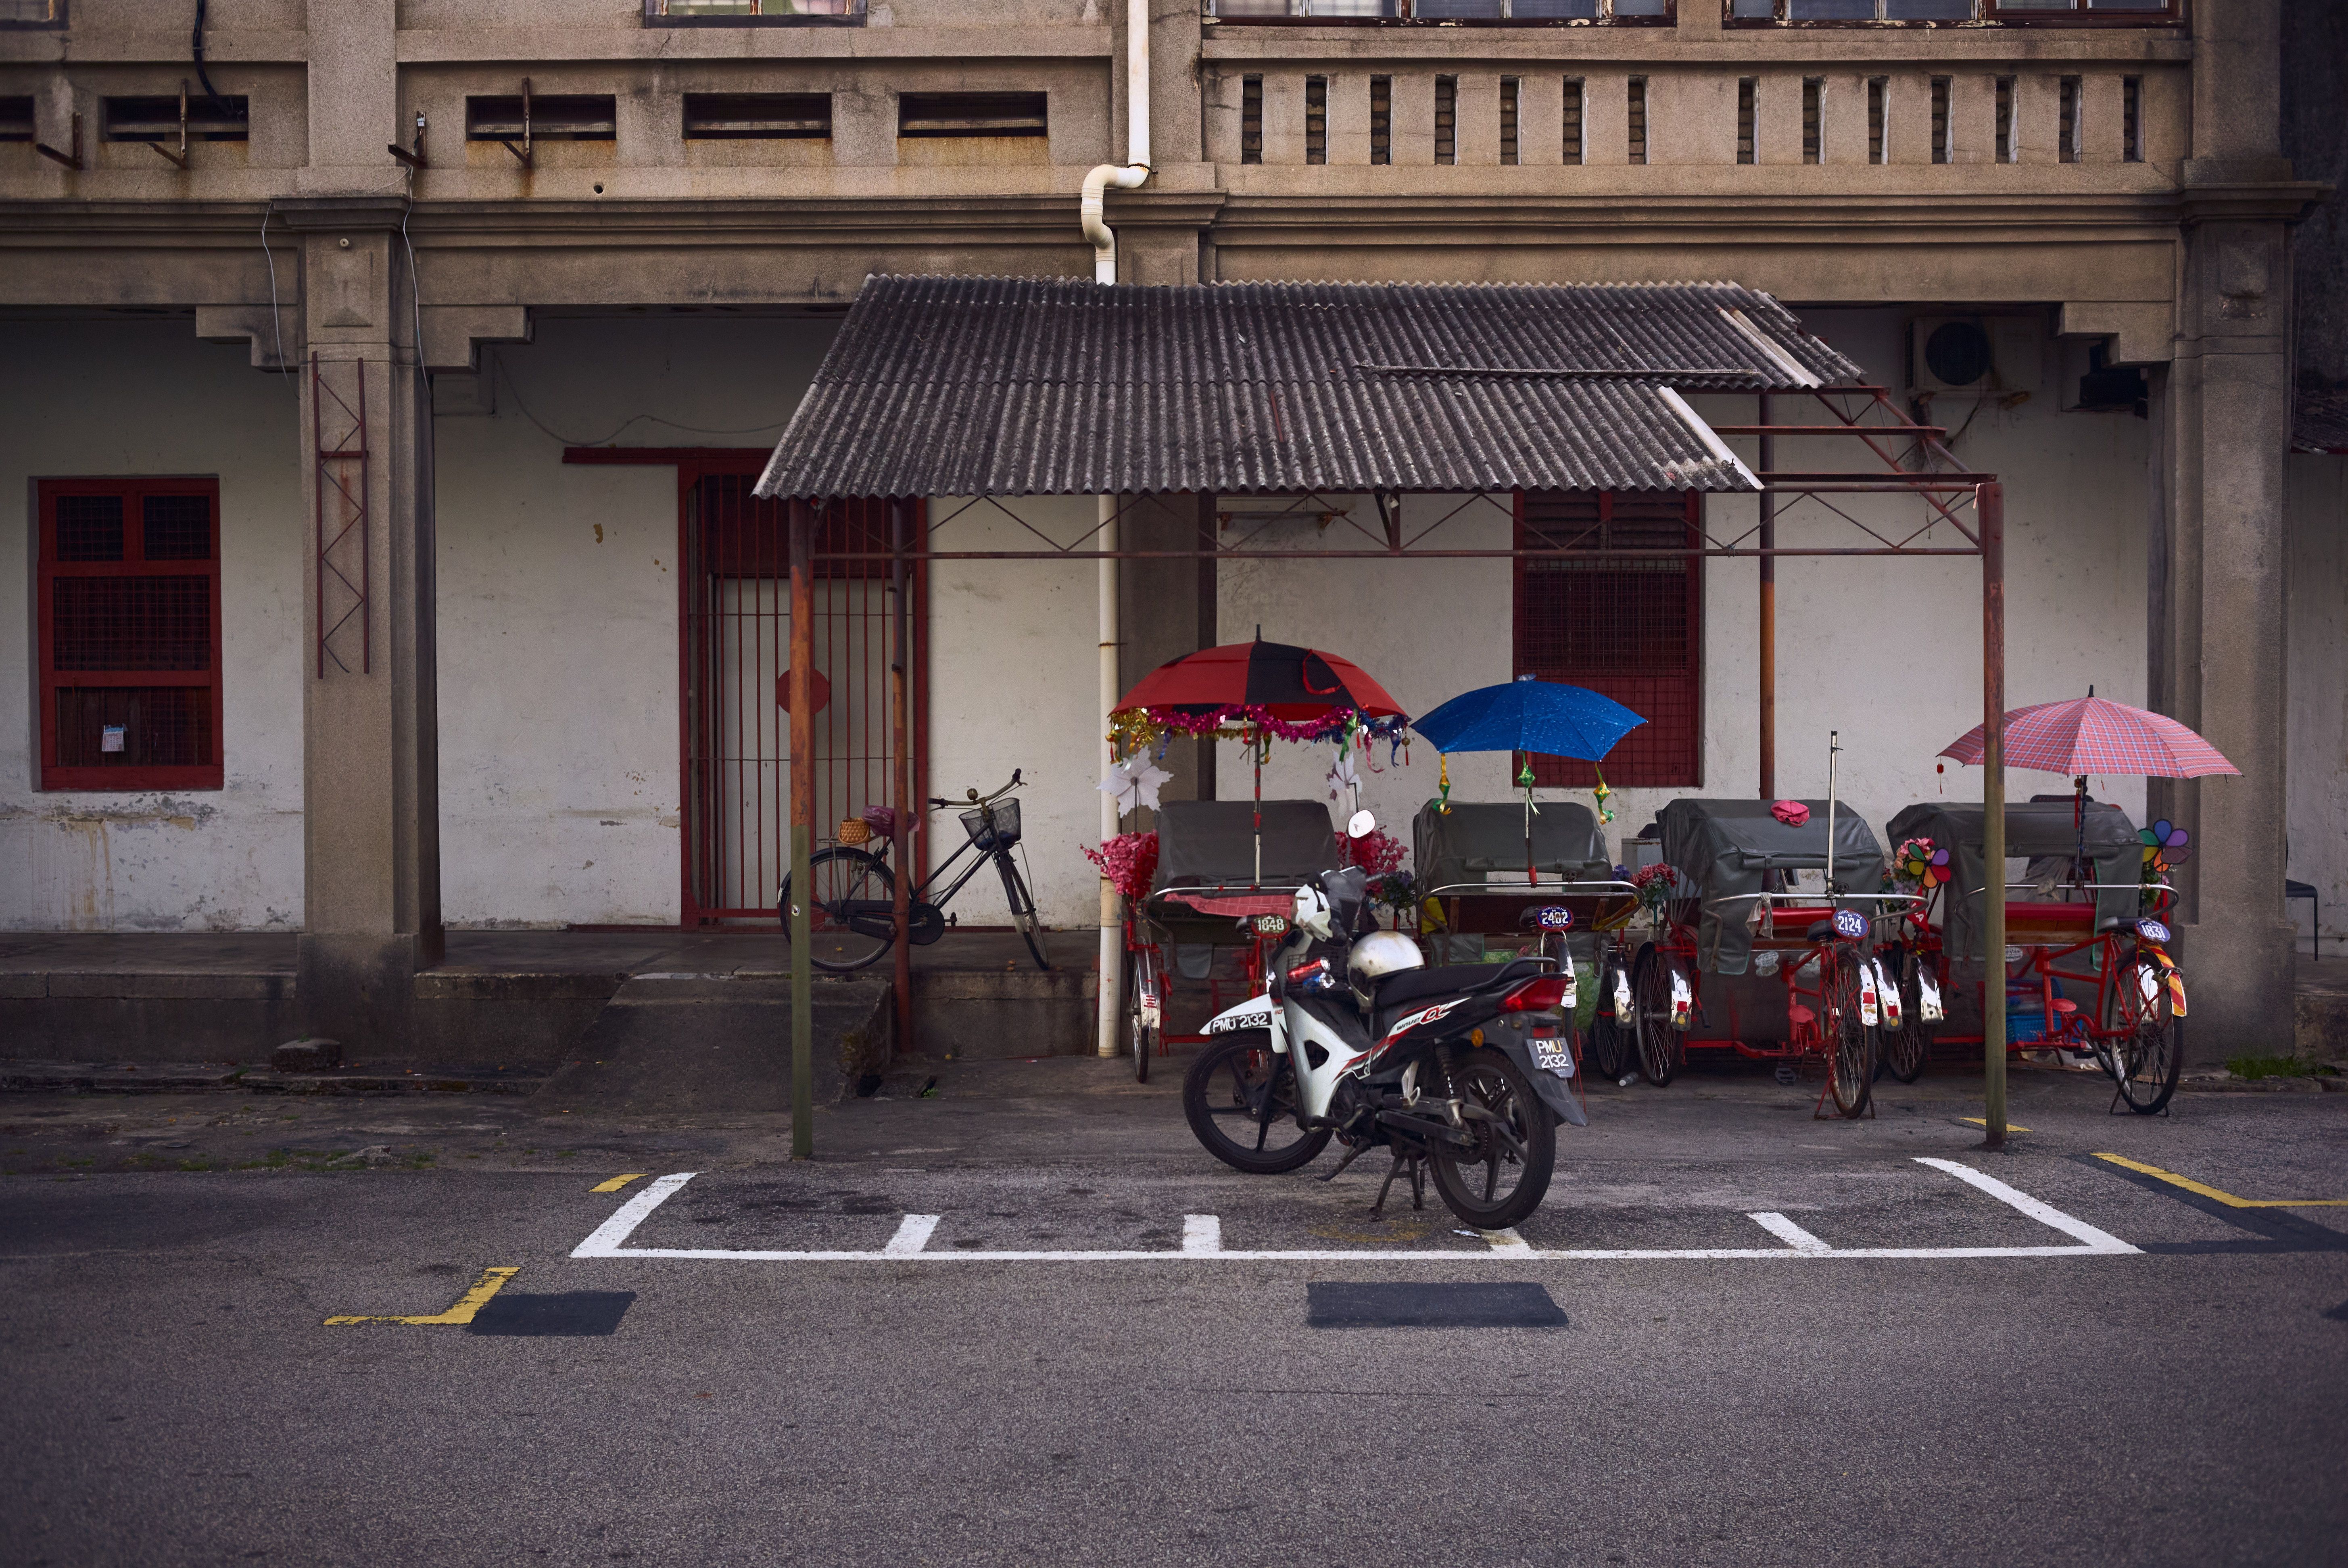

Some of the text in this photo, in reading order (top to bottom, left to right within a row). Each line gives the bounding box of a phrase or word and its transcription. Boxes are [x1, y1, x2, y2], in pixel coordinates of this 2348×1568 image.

[1257, 918, 1284, 931] 1848
[1838, 915, 1862, 933] 2124
[2141, 924, 2166, 938] 1831
[1213, 1013, 1268, 1032] PMU 2132
[1535, 1040, 1562, 1054] PMU
[1539, 1054, 1569, 1068] 2132
